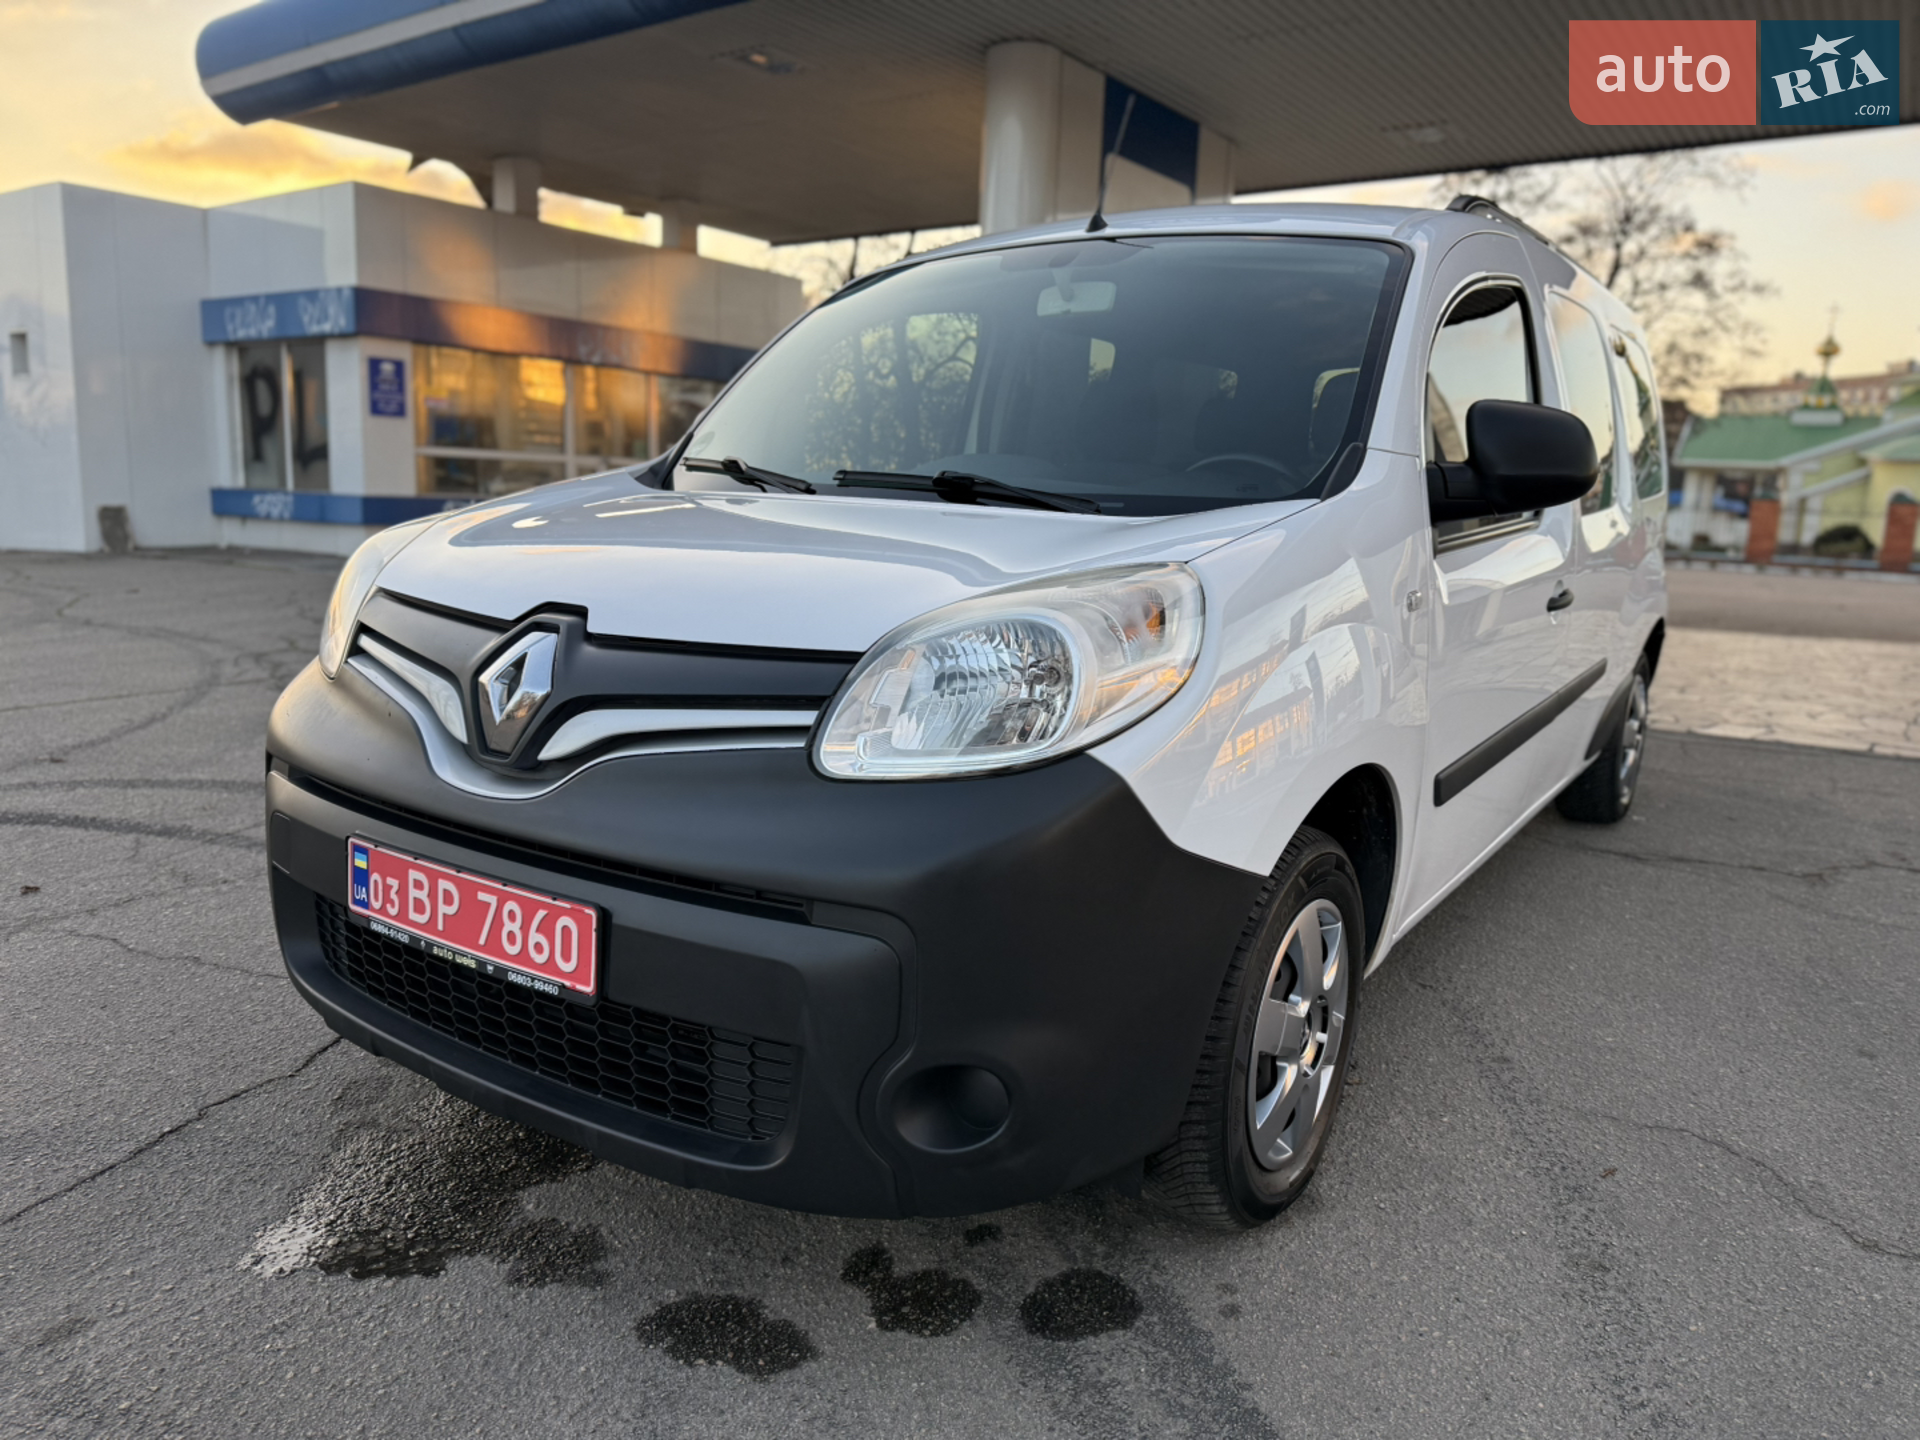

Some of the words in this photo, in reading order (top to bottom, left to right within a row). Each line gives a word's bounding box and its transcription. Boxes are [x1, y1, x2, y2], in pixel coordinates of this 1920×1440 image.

[354, 884, 368, 902] UA
[369, 872, 400, 917] 03
[408, 868, 460, 932] BP
[476, 891, 579, 973] 7860
[433, 946, 453, 960] auto
